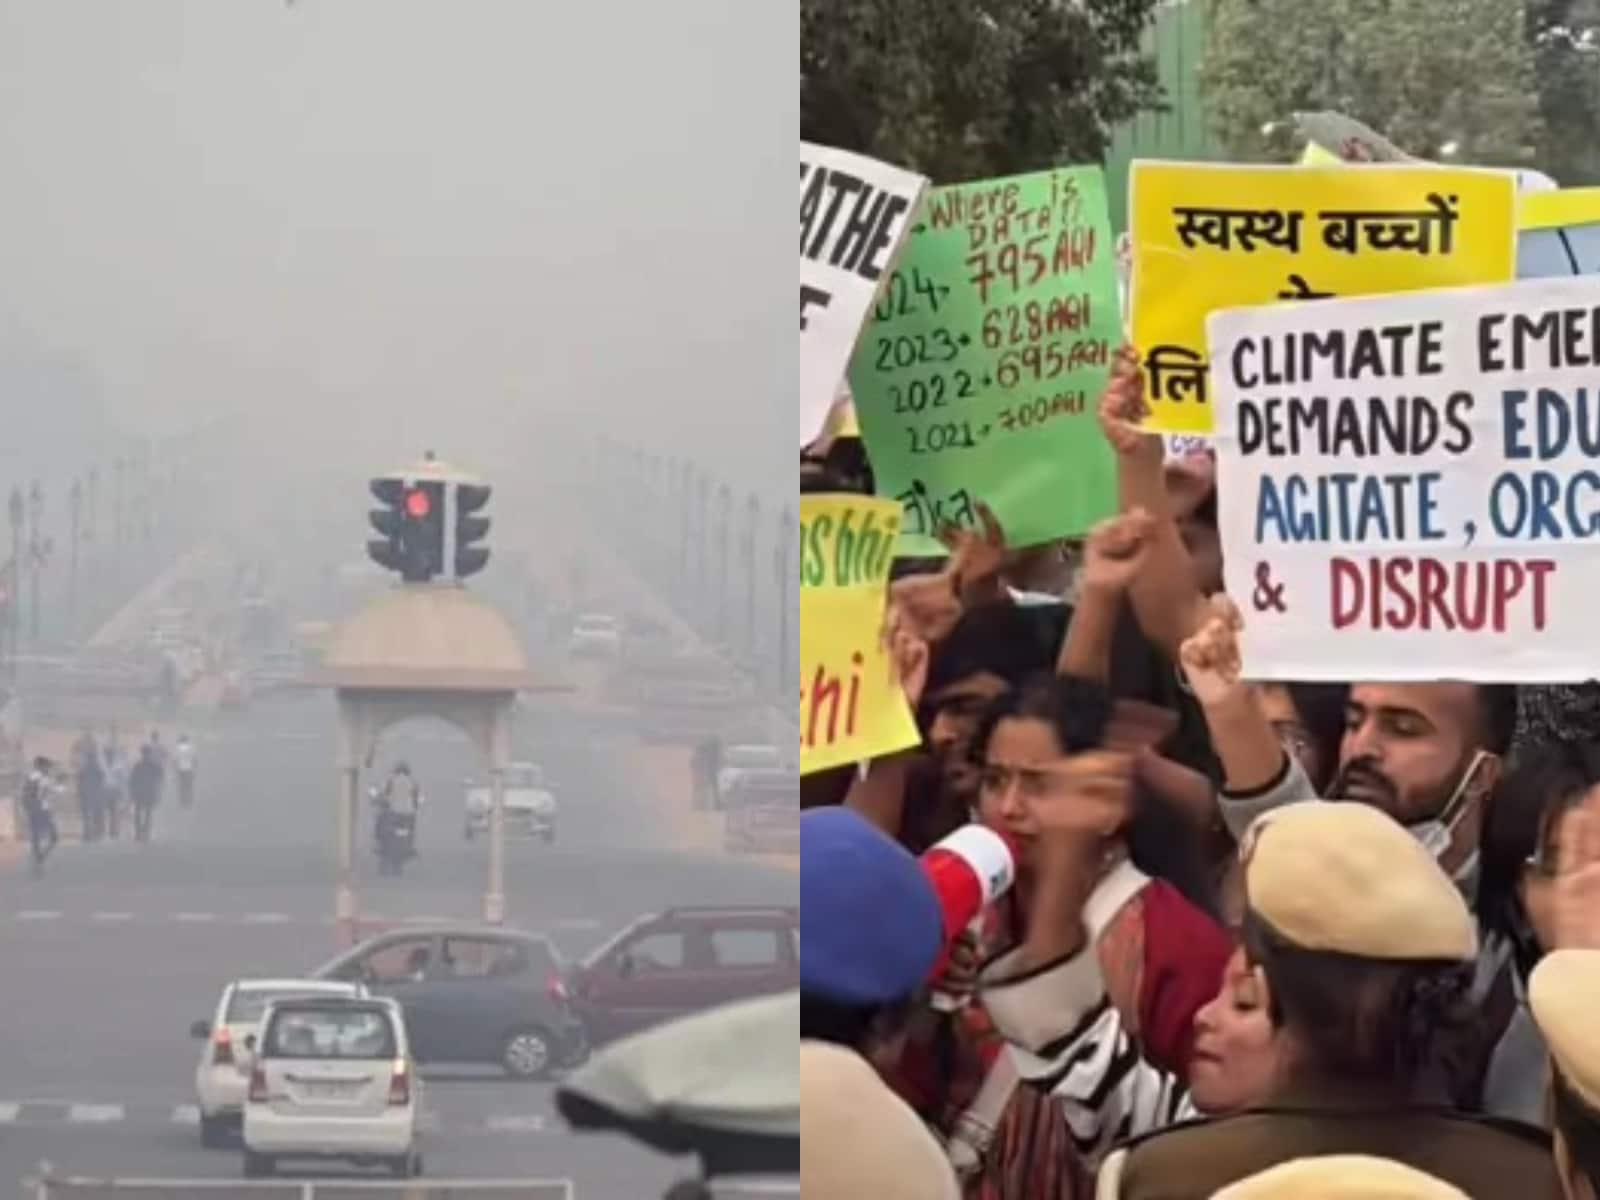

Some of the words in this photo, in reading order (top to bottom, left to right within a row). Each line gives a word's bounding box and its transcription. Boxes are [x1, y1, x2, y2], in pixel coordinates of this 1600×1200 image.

[800, 160, 909, 282] ATHE
[1174, 206, 1304, 253] स्वस्थ
[1318, 192, 1459, 254] बच्चों
[1231, 321, 1444, 389] CLIMATE
[1237, 391, 1475, 457] DEMANDS
[1252, 560, 1287, 613] &
[1329, 556, 1557, 633] DISRUPT
